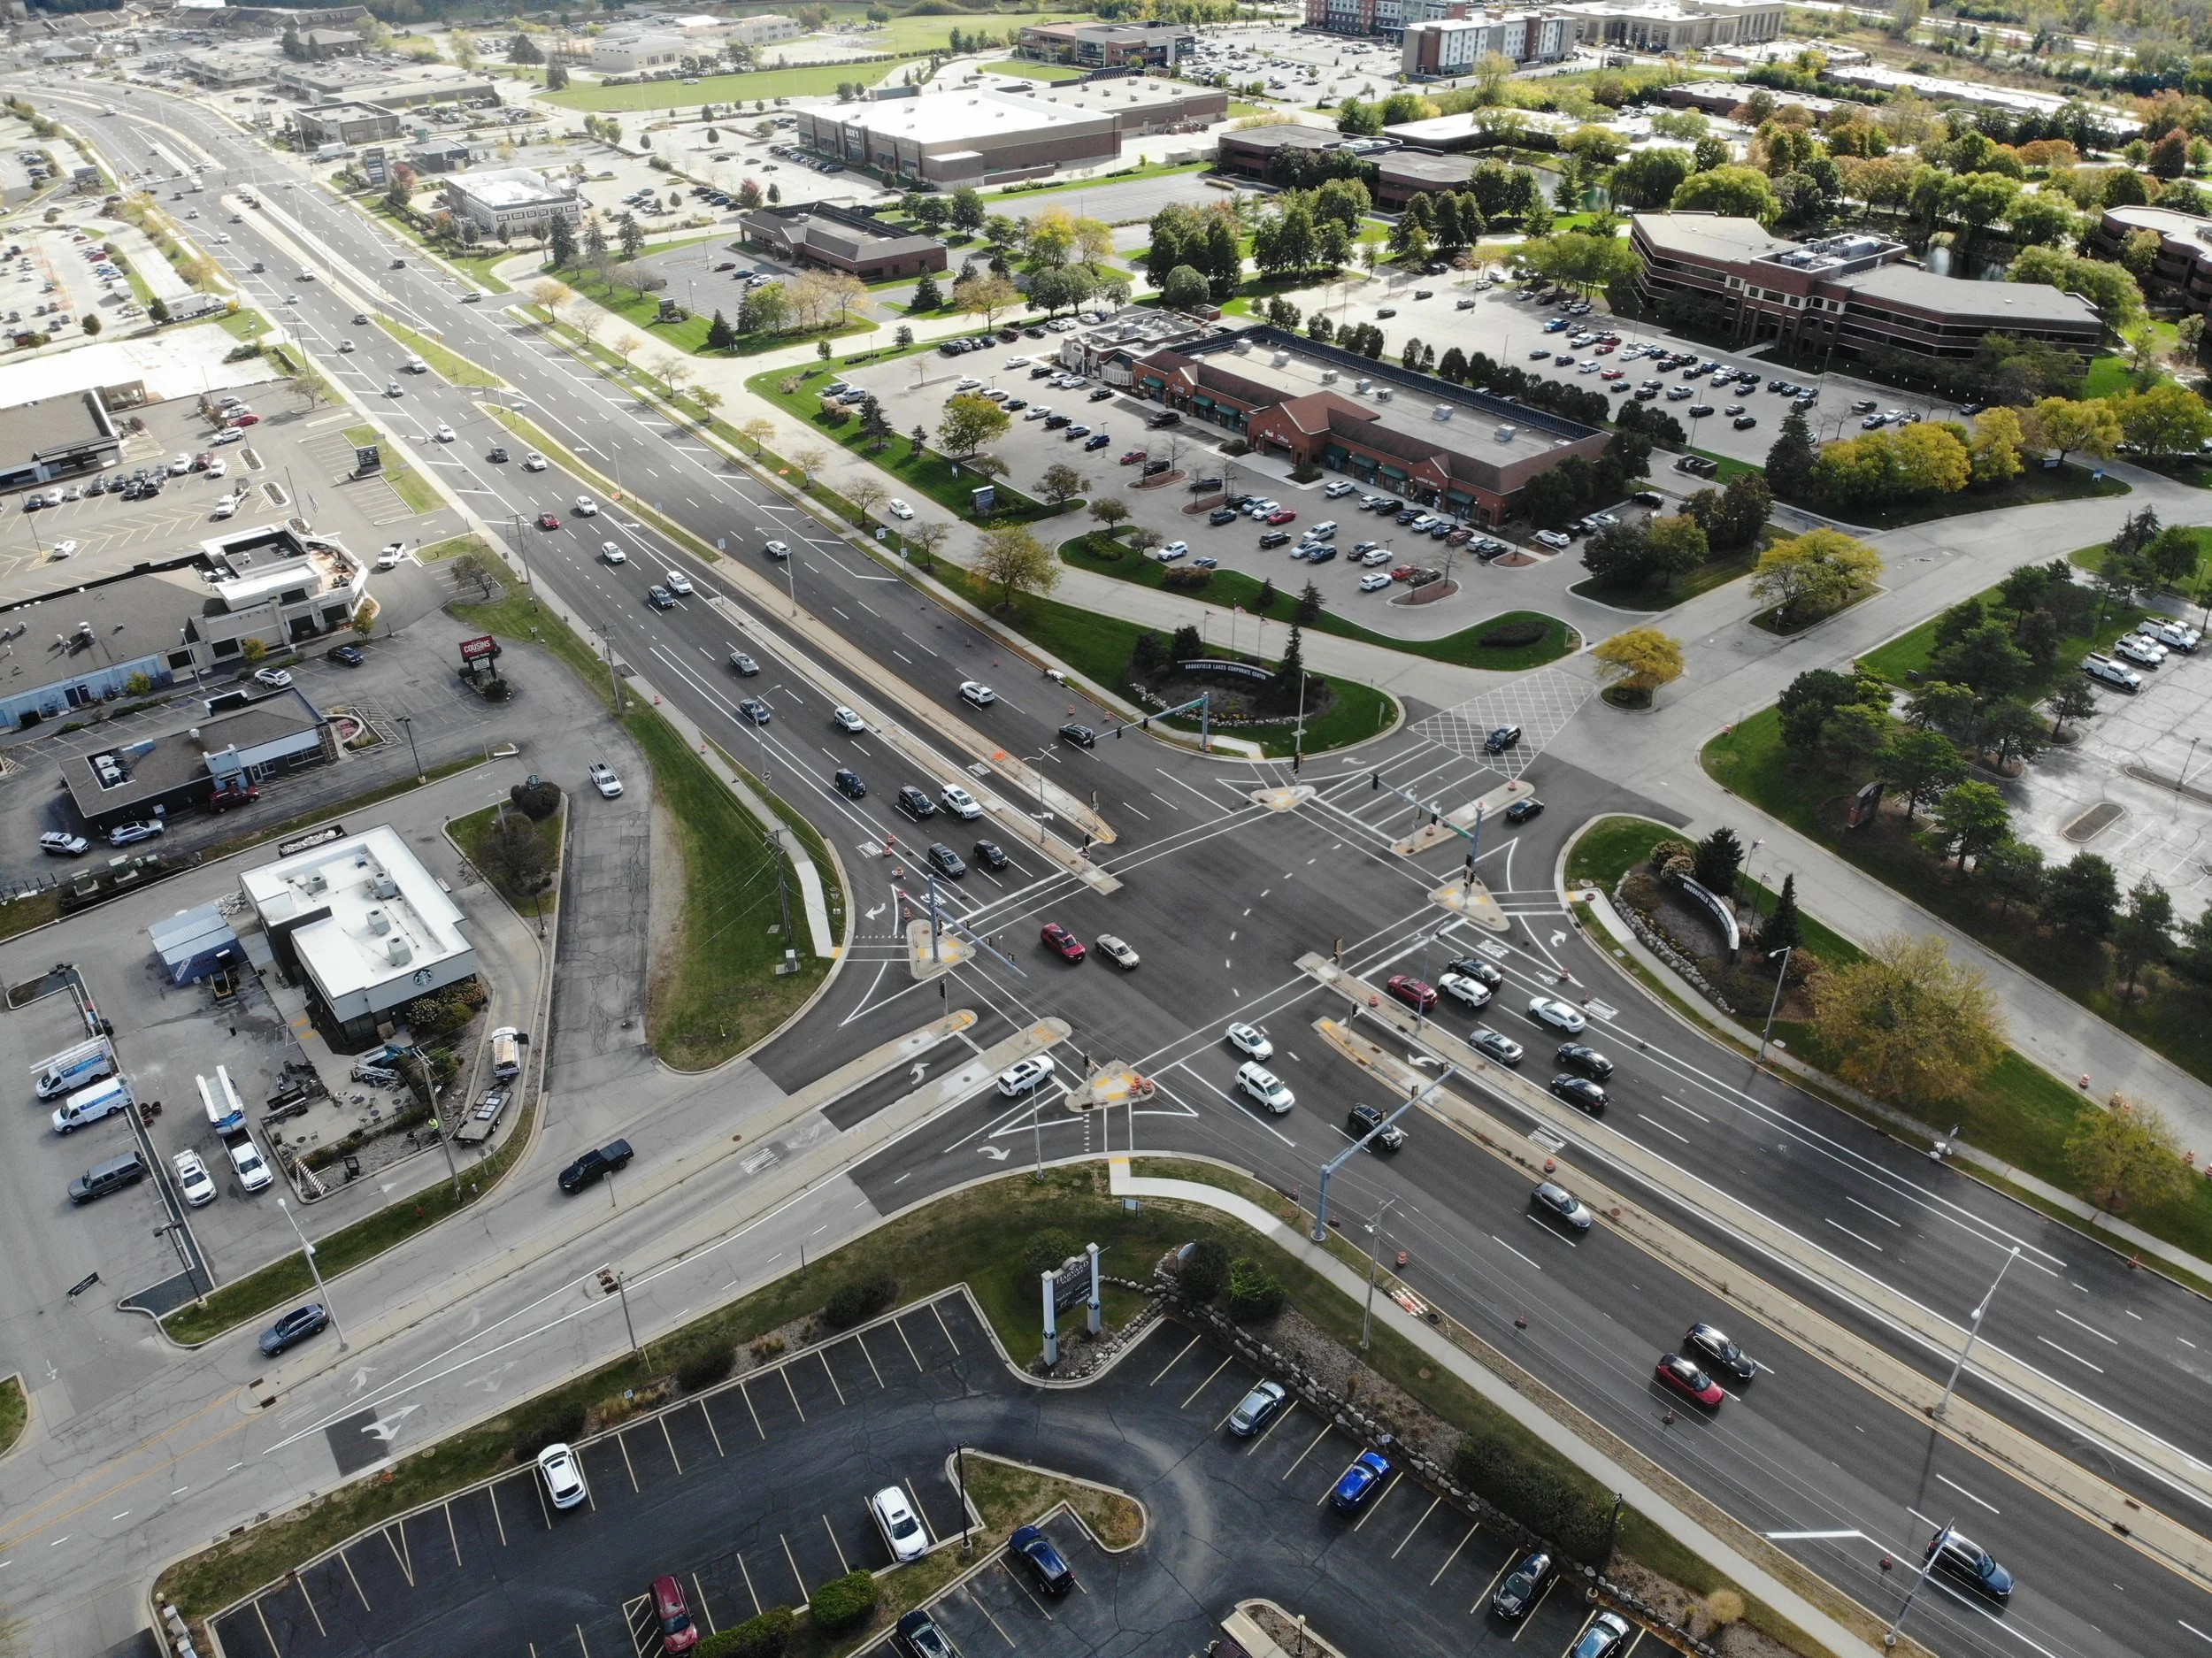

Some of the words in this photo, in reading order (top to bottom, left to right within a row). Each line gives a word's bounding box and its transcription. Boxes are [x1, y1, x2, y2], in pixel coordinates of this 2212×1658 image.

[845, 127, 859, 138] DICK'S
[464, 640, 491, 653] COUSINS
[1227, 665, 1251, 676] CORPORATE
[1251, 671, 1266, 680] CENTER
[855, 841, 883, 859] ONLY
[1683, 882, 1709, 904] BROOKFIELD
[1584, 997, 1620, 1020] ONLY
[1527, 1125, 1567, 1154] ONLY
[740, 1148, 780, 1176] ONLY
